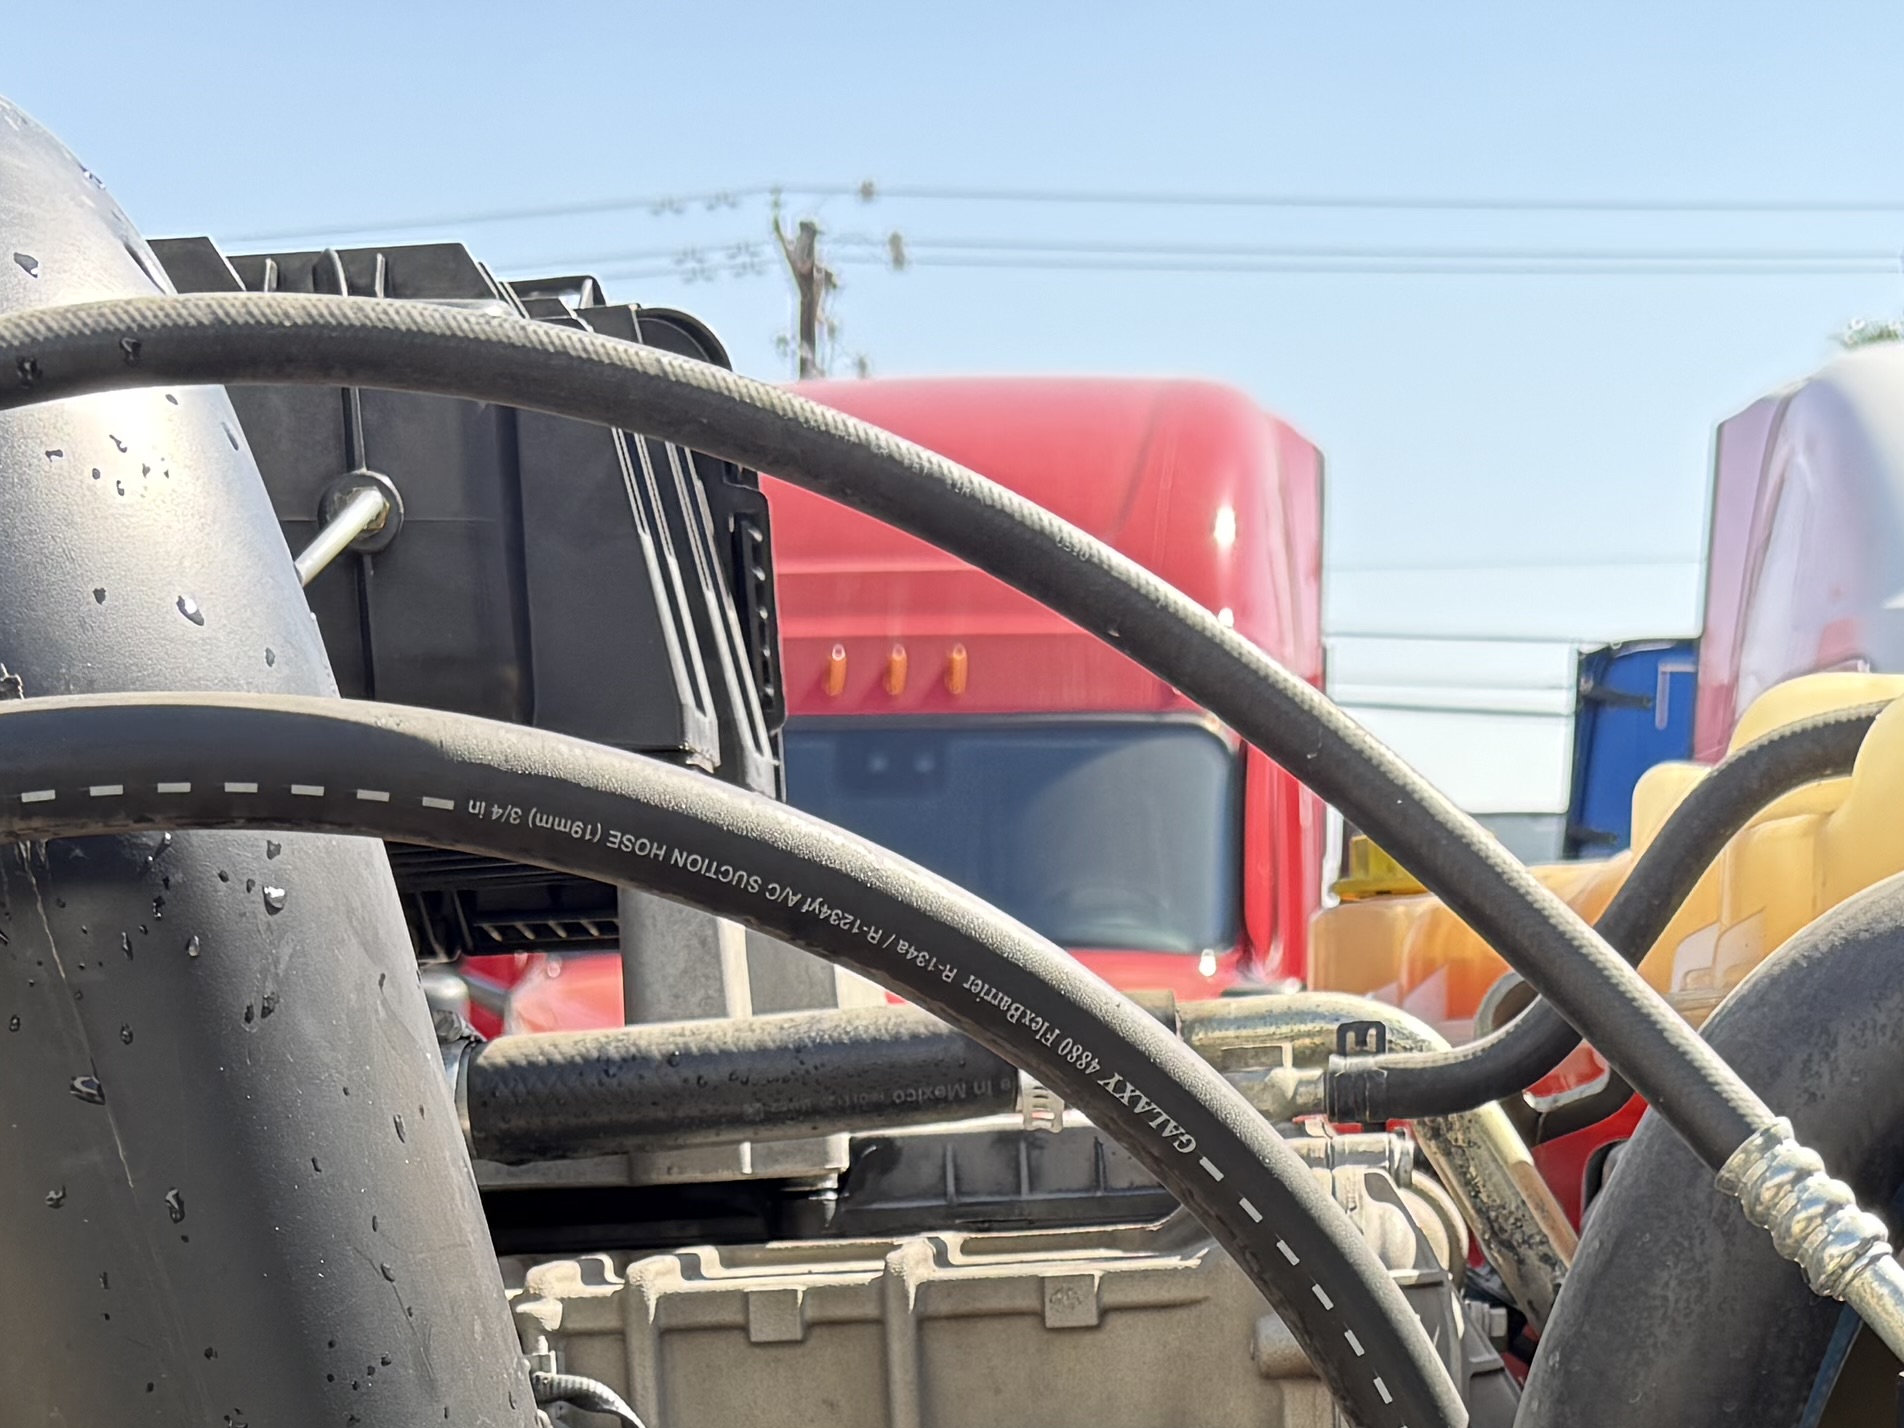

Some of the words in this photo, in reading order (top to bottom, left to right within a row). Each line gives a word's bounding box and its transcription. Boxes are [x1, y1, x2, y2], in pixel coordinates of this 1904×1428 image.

[468, 800, 486, 816] in
[491, 805, 523, 824] 3/4
[528, 807, 602, 844] (19mm)
[606, 830, 667, 861] HOSE
[670, 848, 763, 893] SUCTION
[765, 882, 803, 908] A/C
[800, 897, 883, 944] R-1234yf
[896, 939, 958, 983] R-134a
[962, 975, 1061, 1047] FlexBarrier
[1058, 1038, 1101, 1075] 4880
[1097, 1072, 1197, 1154] GALAXY
